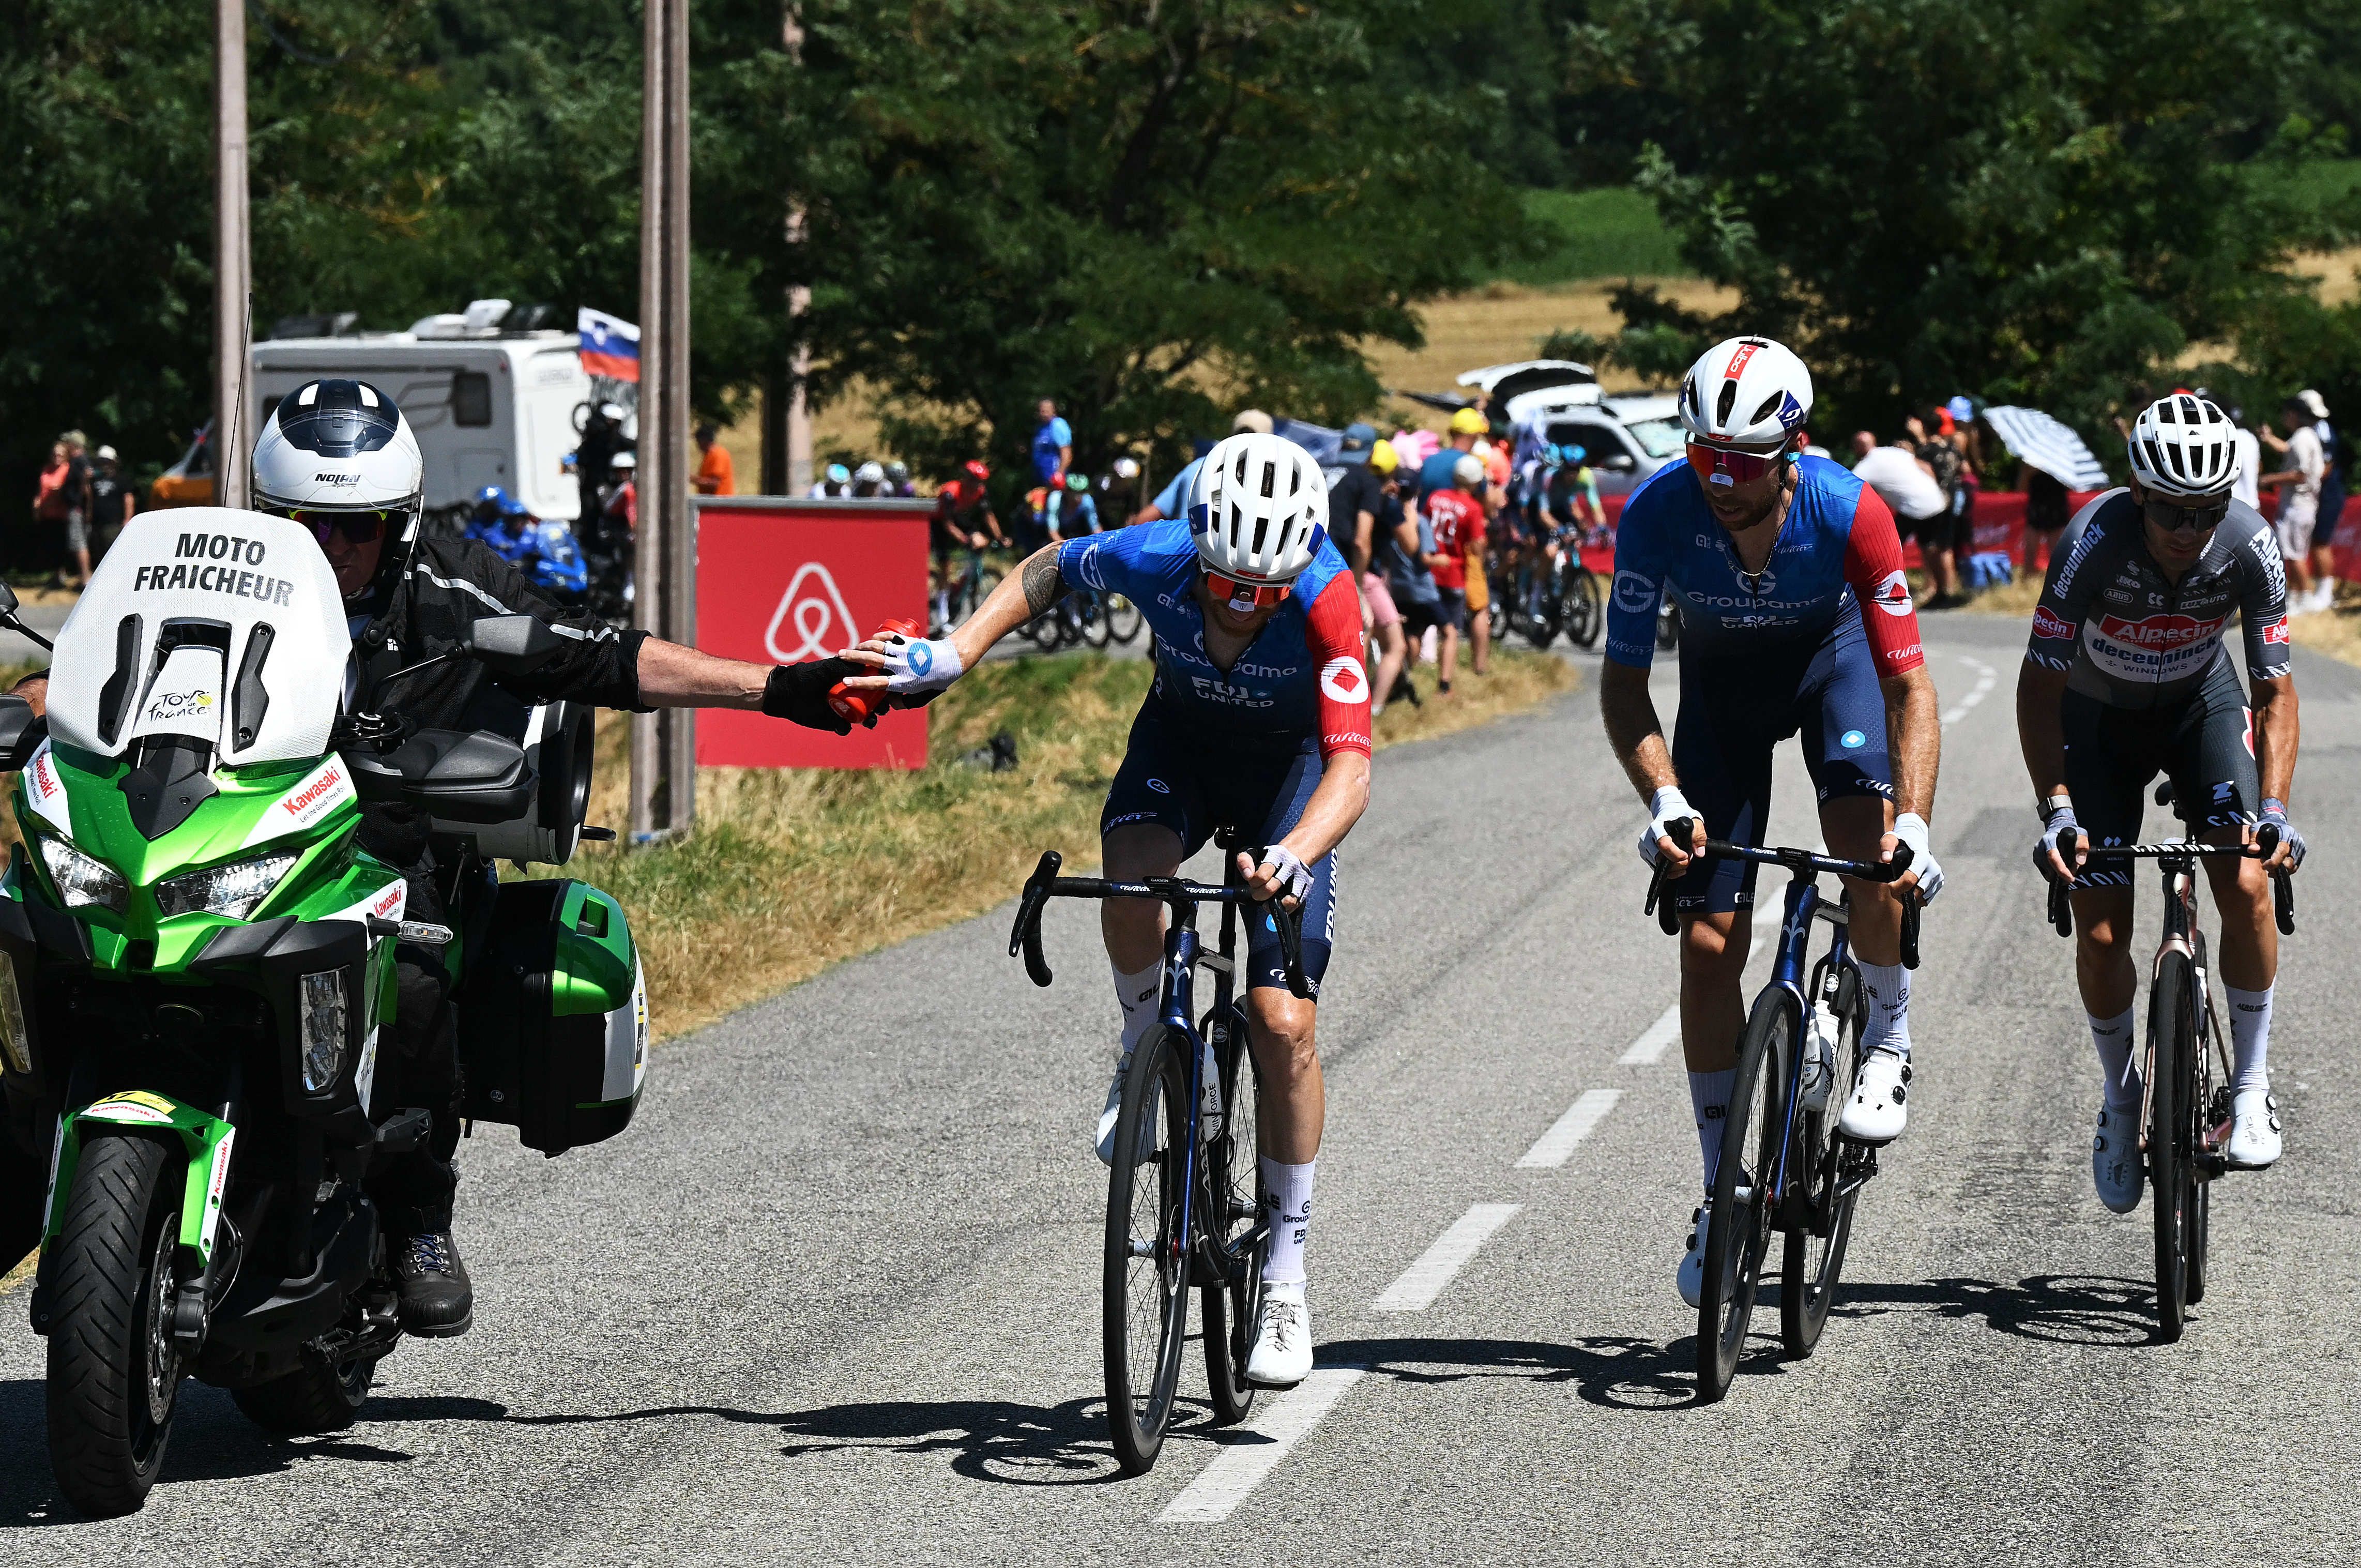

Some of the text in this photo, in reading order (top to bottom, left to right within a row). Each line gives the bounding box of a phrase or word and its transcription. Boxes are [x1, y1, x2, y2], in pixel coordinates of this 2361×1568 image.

[315, 474, 361, 485] NOLAN
[175, 532, 266, 566] MOTO
[2052, 523, 2106, 600] deceuninck
[133, 564, 295, 607] FRAICHEUR
[1686, 591, 1825, 610] Groupama
[2106, 590, 2129, 601] ABUS
[2114, 623, 2215, 643] Alpecin
[2092, 635, 2217, 666] deceuninck
[2123, 663, 2188, 675] WINDOWS
[1191, 675, 1249, 699] FDJ
[1196, 689, 1274, 708] UNITED
[36, 747, 58, 799] Kawasaki
[282, 766, 341, 816] Kawasaki
[299, 813, 310, 823] Let
[308, 808, 316, 817] the
[315, 799, 328, 811] Good
[326, 791, 339, 802] Times
[2130, 844, 2216, 852] CANYON
[373, 885, 401, 918] Kawasaki
[1324, 899, 1336, 943] FDJ
[91, 1105, 157, 1118] Kawasaki
[214, 1140, 229, 1195] Kawasaki
